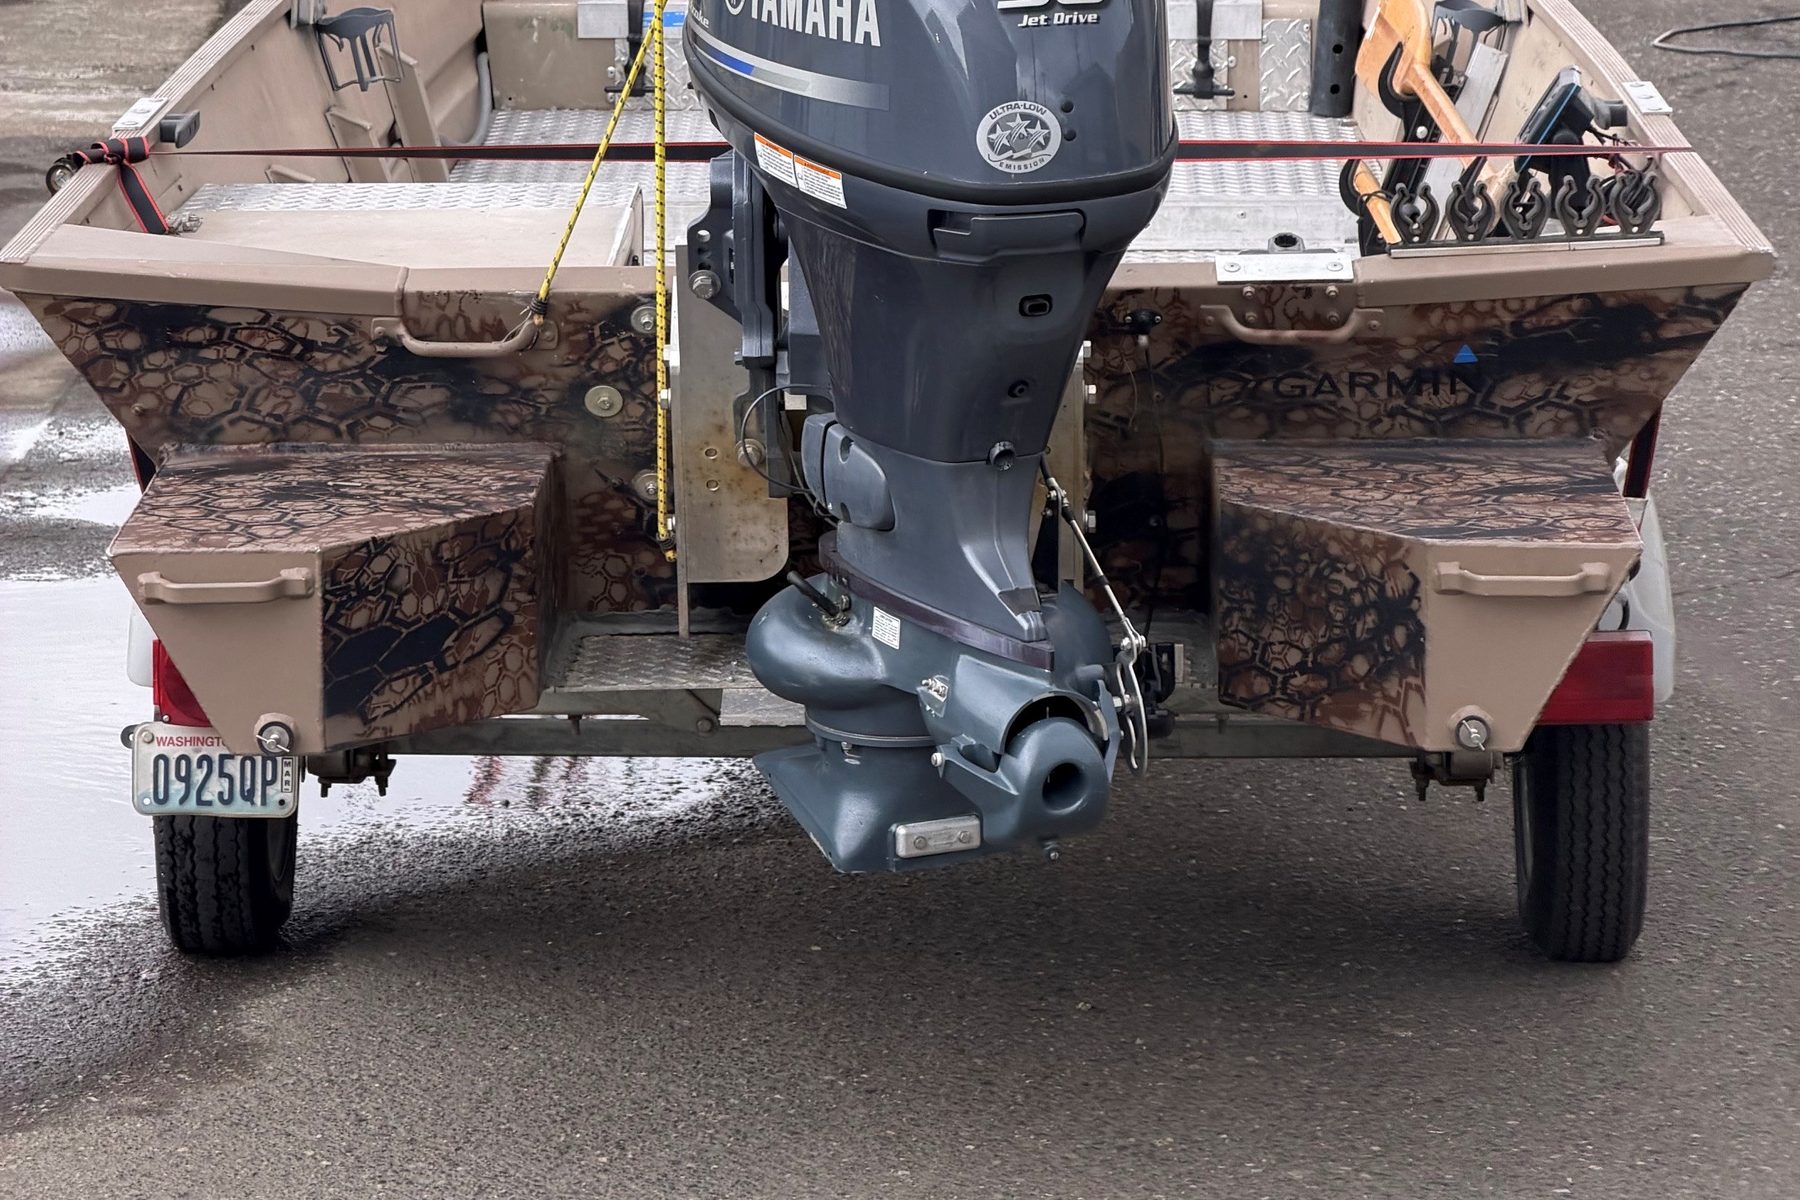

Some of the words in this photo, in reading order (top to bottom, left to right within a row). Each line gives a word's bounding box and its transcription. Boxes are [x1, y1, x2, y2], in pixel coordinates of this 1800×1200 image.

[1017, 14, 1049, 27] Jet
[1053, 11, 1098, 25] Drive
[999, 158, 1046, 171] EMISSION
[1272, 367, 1485, 398] GARMIN
[156, 736, 228, 747] WASHINGT
[153, 753, 278, 807] 0925QP
